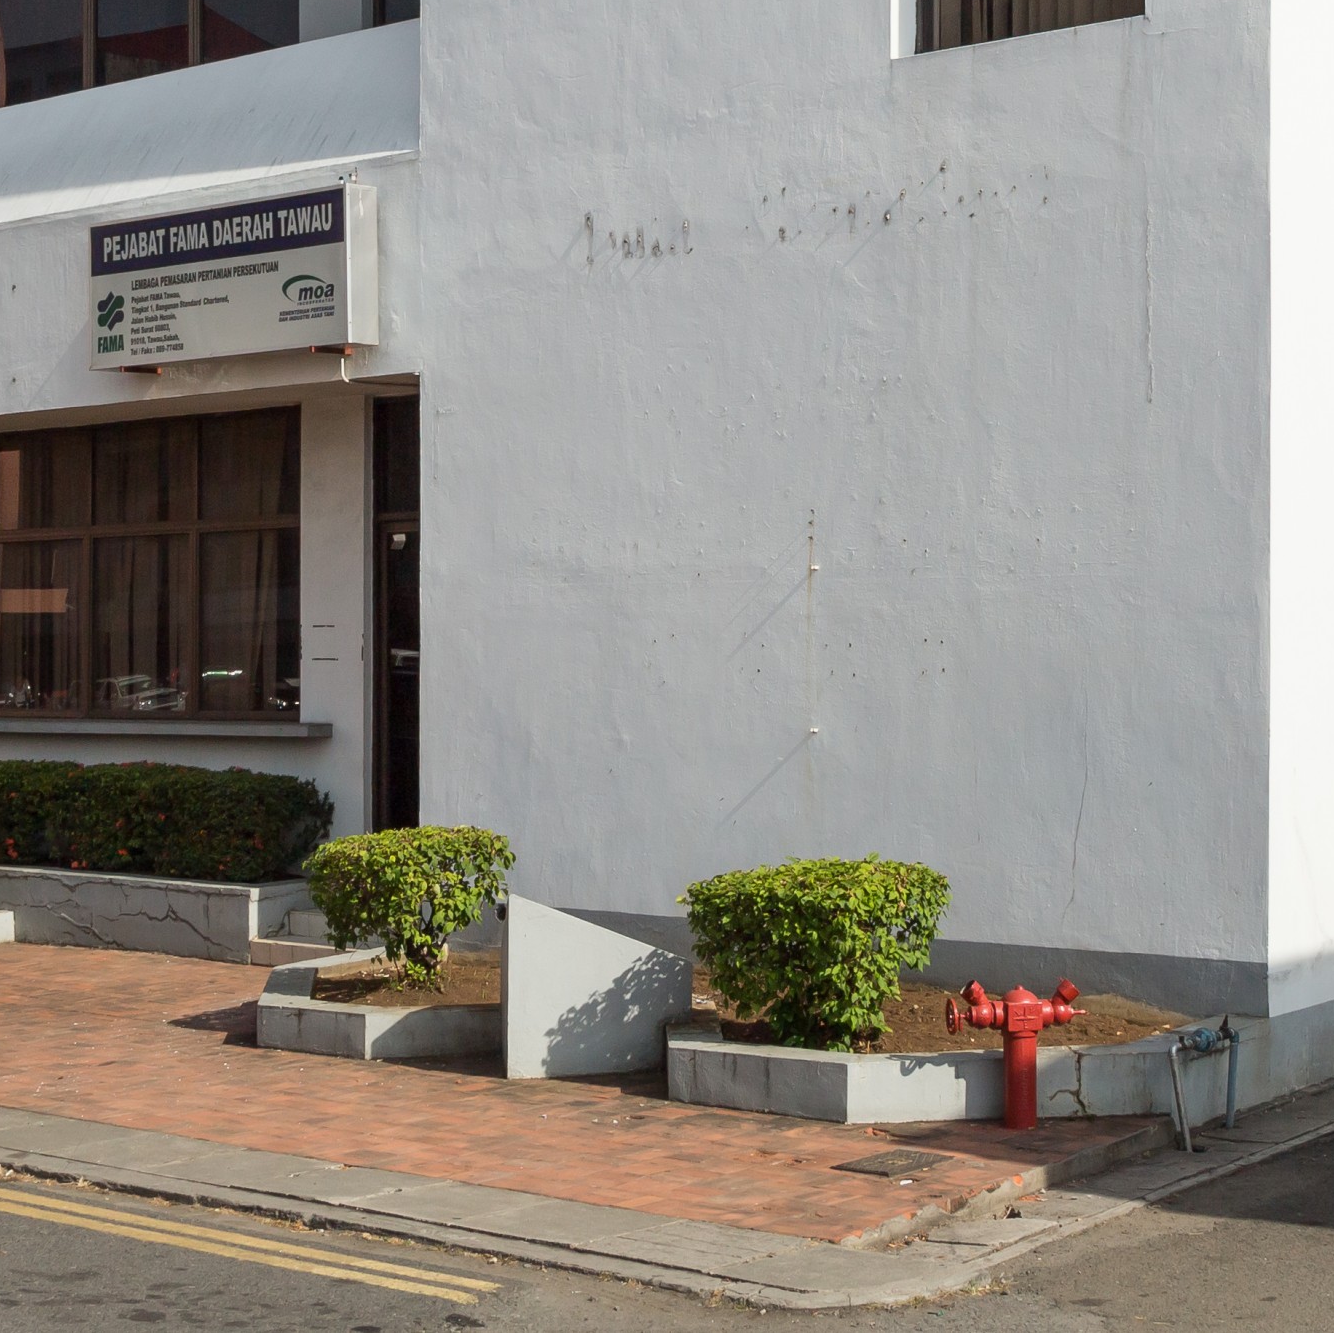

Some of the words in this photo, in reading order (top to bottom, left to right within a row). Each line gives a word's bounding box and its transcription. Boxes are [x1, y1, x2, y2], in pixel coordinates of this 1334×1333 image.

[103, 229, 165, 262] PEJABAT
[169, 222, 209, 253] FAMA
[212, 212, 274, 247] DAERAH
[277, 203, 333, 237] TAWAU
[131, 277, 159, 291] LEMBAGA
[160, 272, 197, 287] PEMASARAN
[197, 267, 232, 282] PERTANIAN
[233, 261, 279, 277] PERSEKUTUAN
[150, 293, 163, 301] FAMA
[298, 283, 335, 301] moa
[98, 334, 124, 353] FAMA
